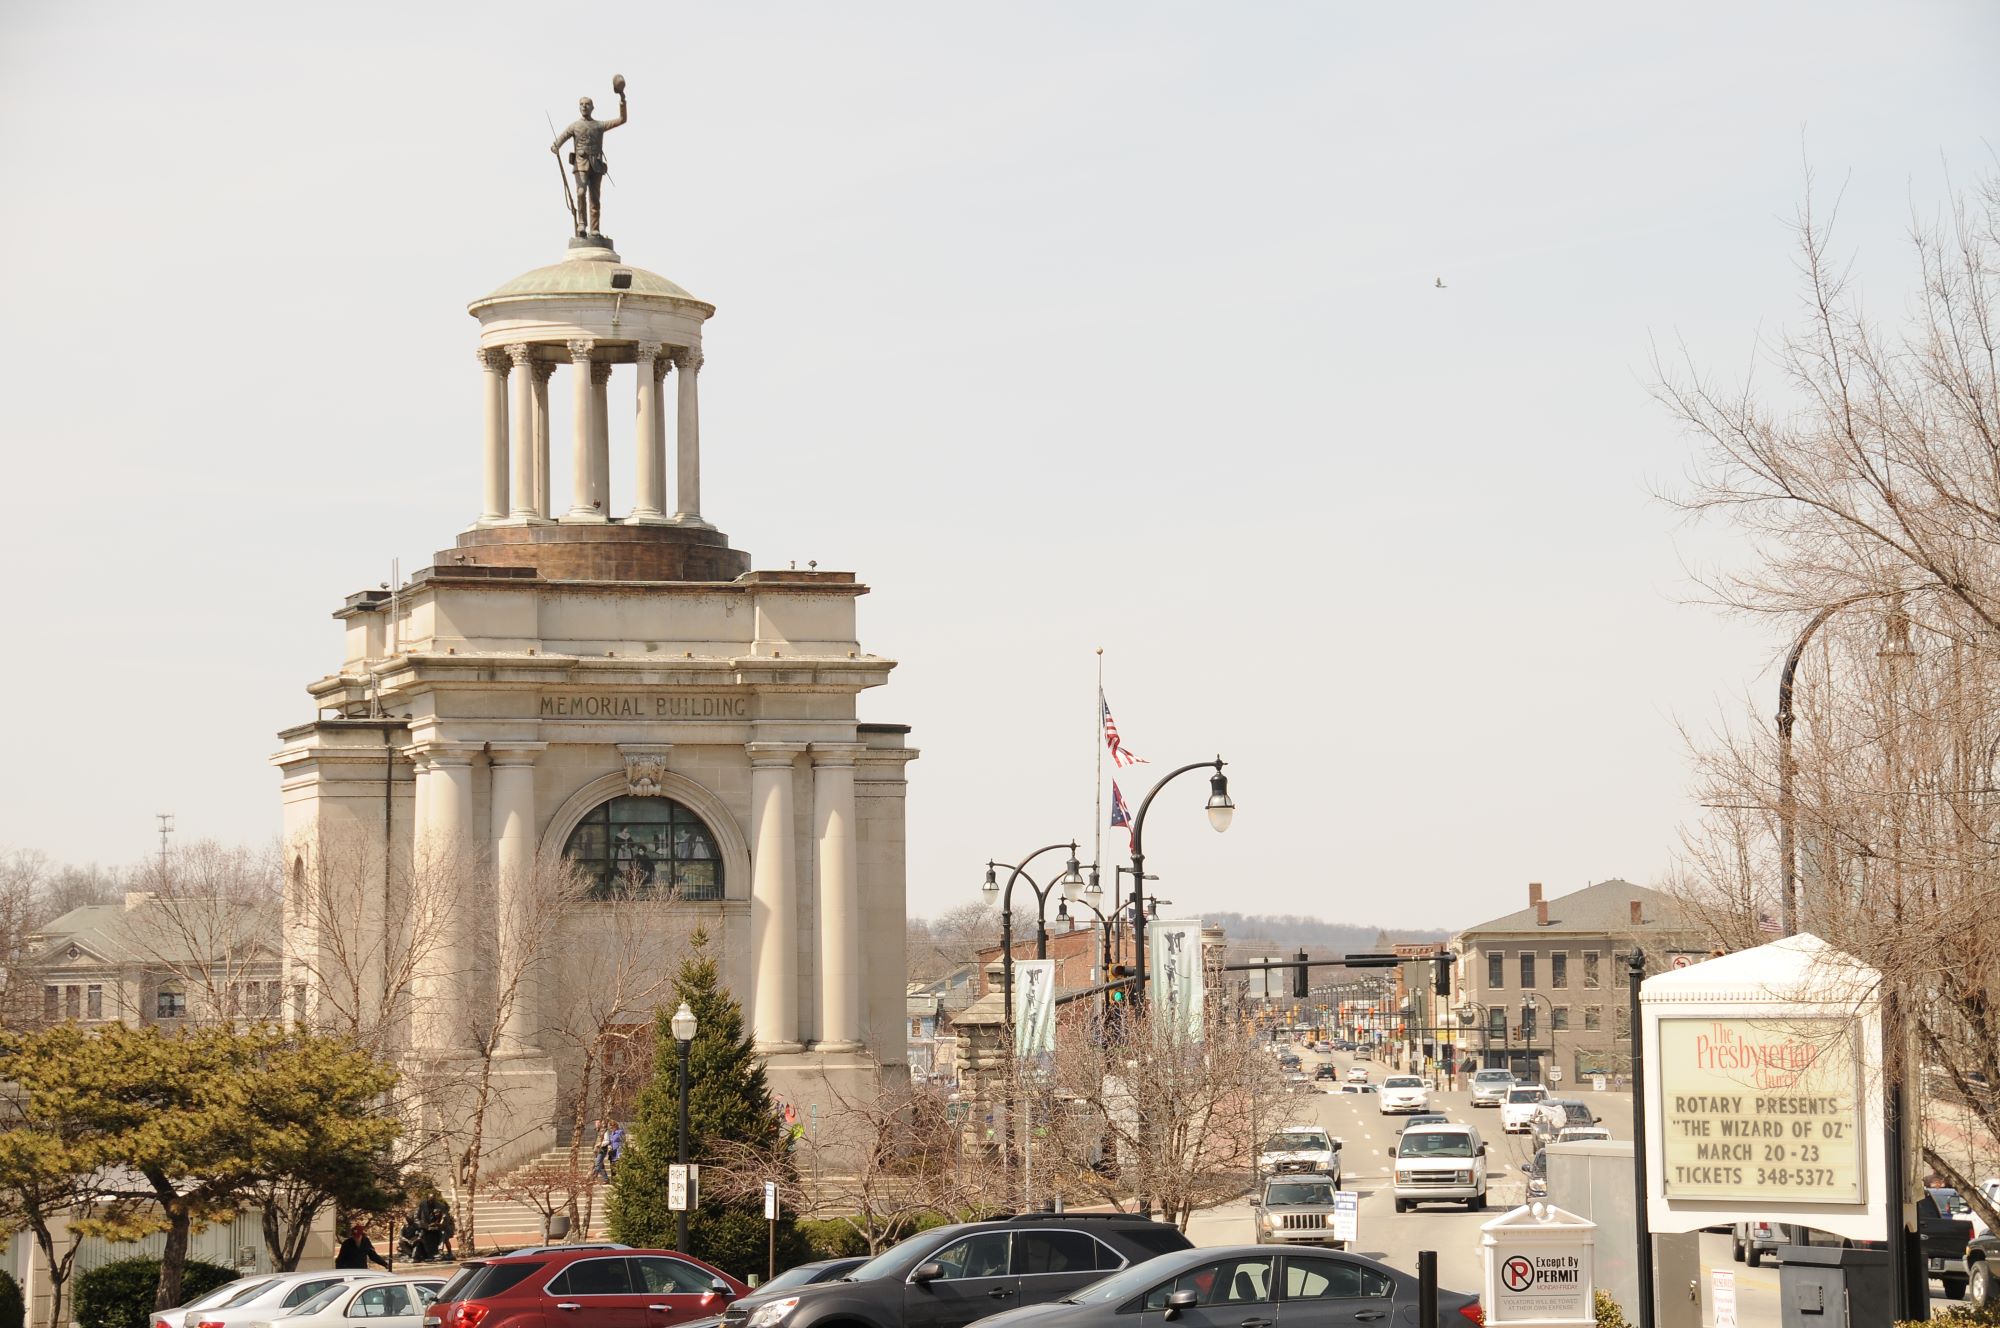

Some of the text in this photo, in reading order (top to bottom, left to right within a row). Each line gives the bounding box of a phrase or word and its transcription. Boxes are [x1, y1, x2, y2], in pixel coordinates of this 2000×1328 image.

[539, 697, 746, 717] MEMORIAL BUILDING
[1712, 1020, 1734, 1045] The
[1696, 1034, 1819, 1077] Presbyterian
[1755, 1068, 1798, 1090] Church
[1675, 1096, 1838, 1115] ROTARY PRESENTS
[1672, 1119, 1853, 1139] "THE WIZARD OF OZ"
[1697, 1143, 1752, 1161] MARCH
[671, 1170, 685, 1179] RIGHT
[1675, 1166, 1835, 1186] TICKETS 348-5372
[671, 1183, 685, 1192] TURN
[671, 1196, 684, 1205] ONLY
[1536, 1256, 1579, 1269] Except By
[1536, 1269, 1580, 1283] PERMIT
